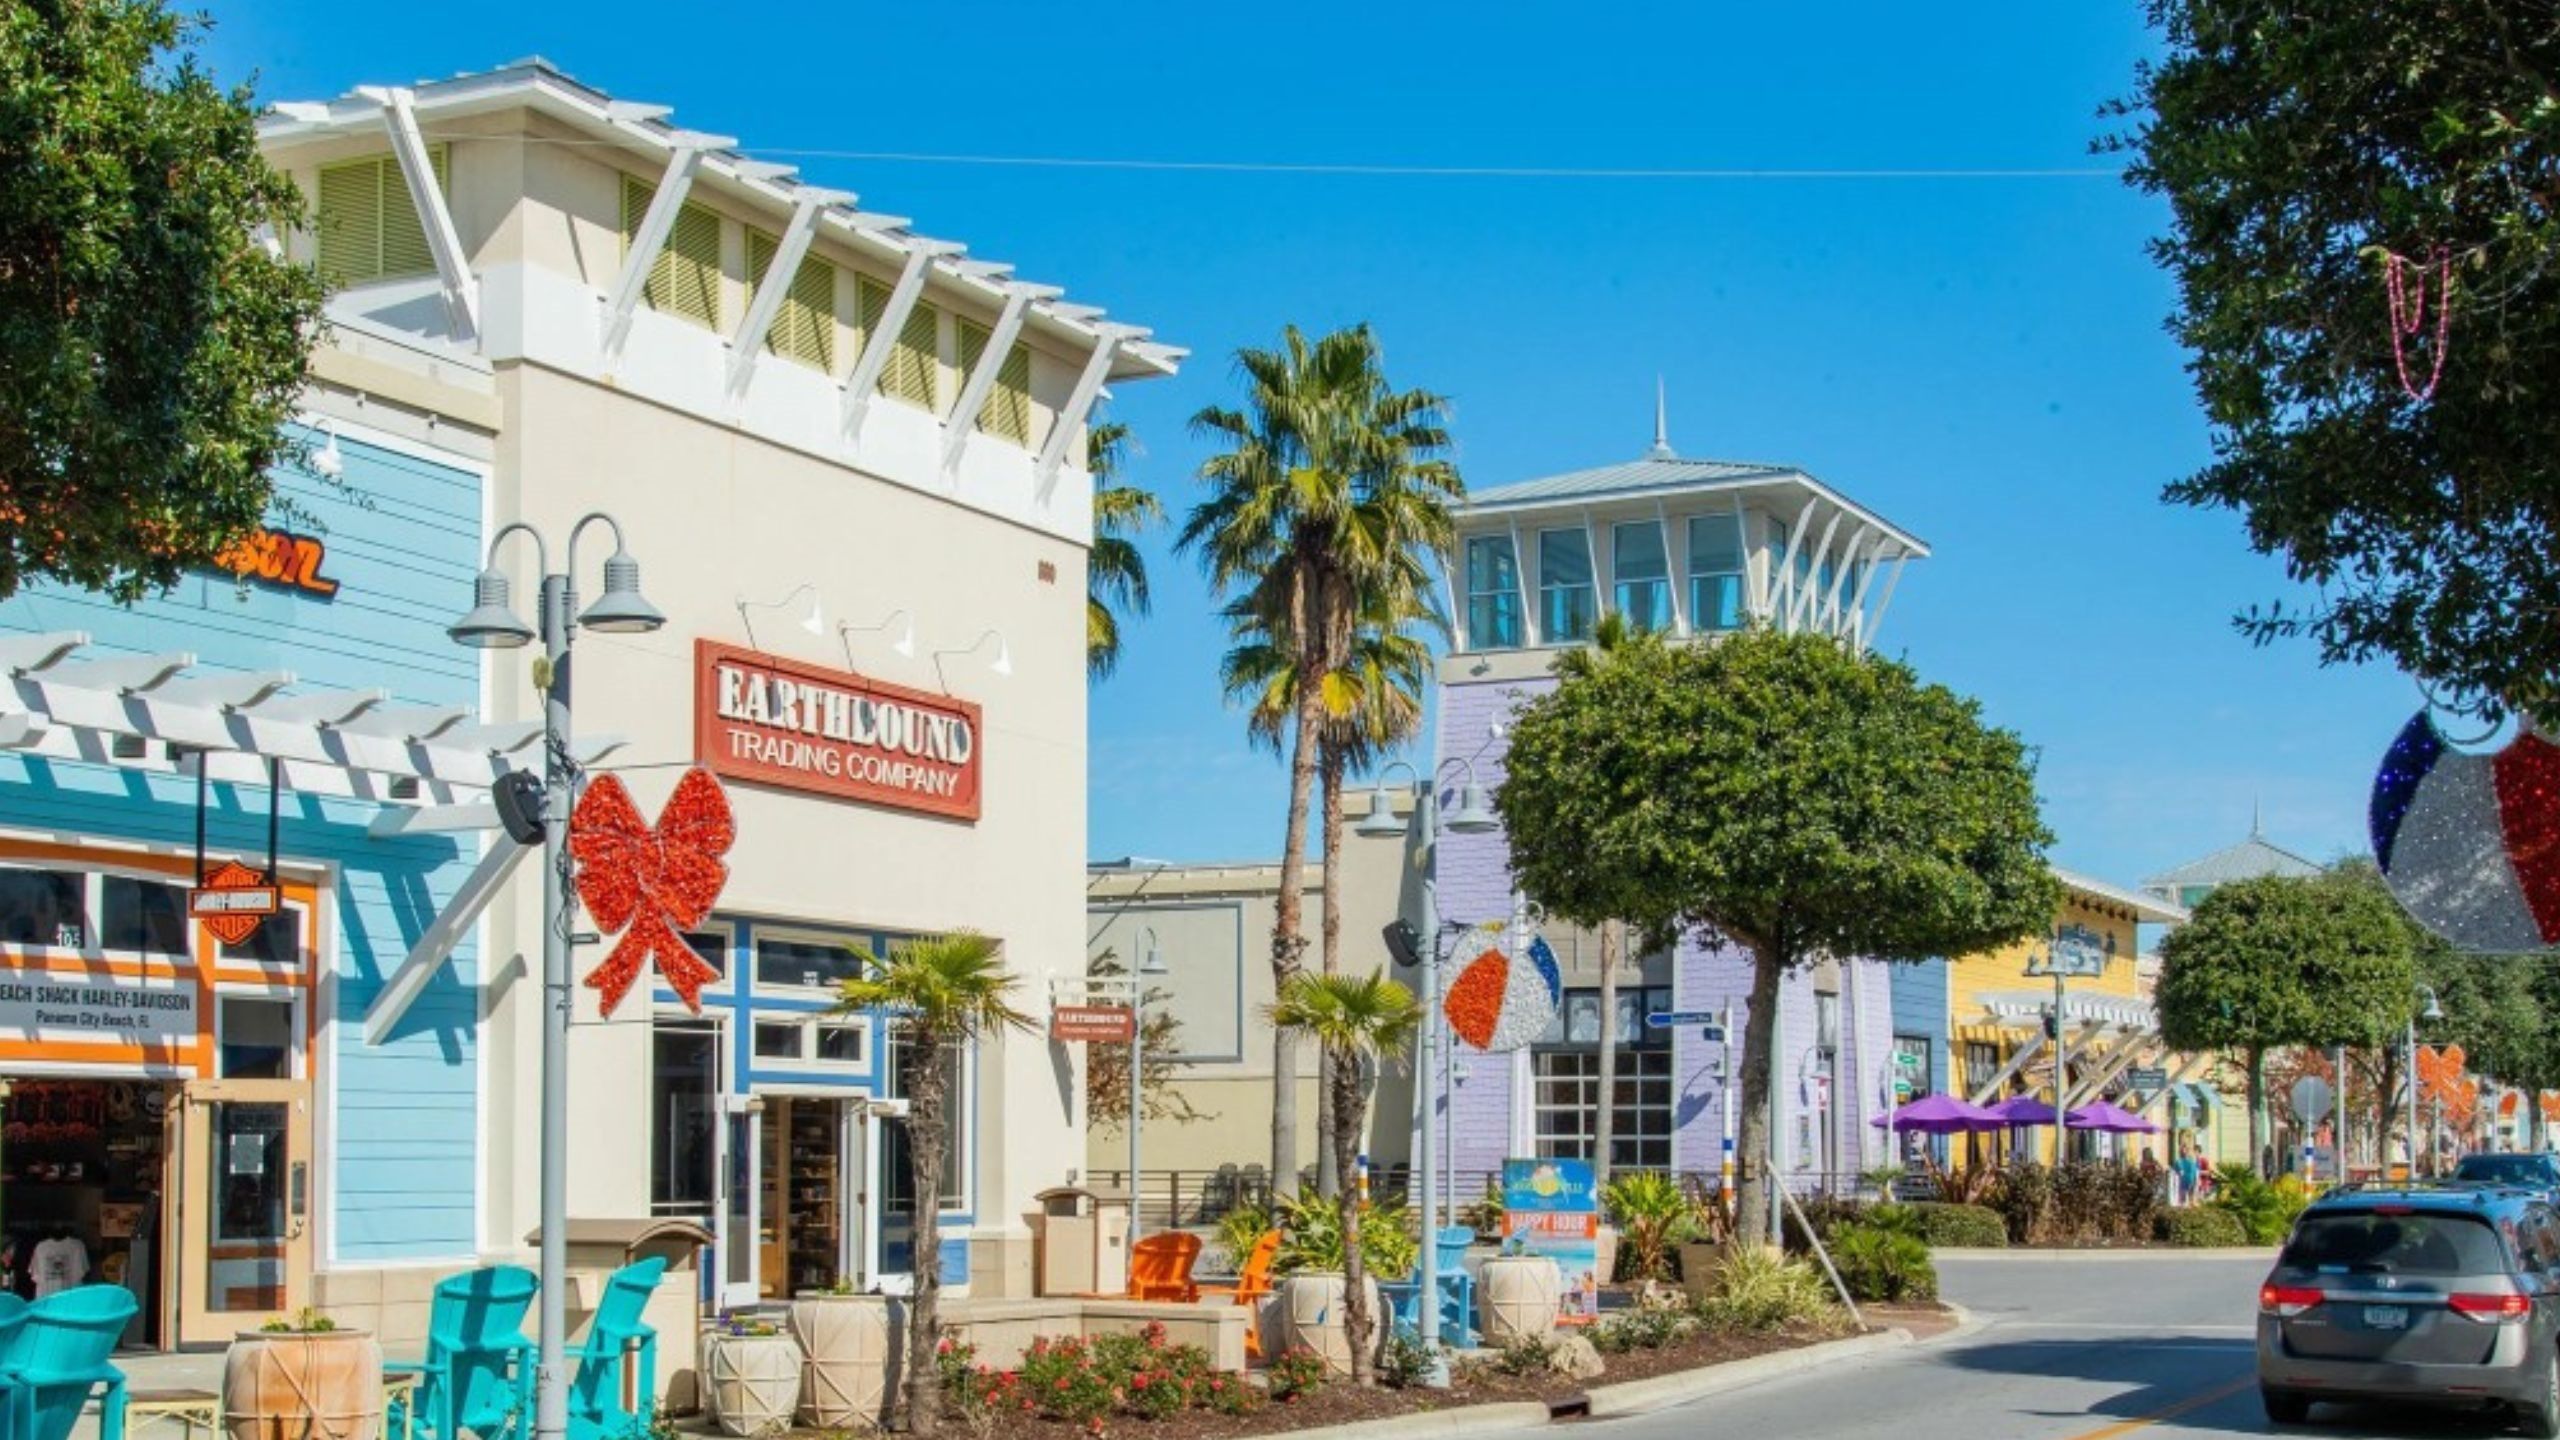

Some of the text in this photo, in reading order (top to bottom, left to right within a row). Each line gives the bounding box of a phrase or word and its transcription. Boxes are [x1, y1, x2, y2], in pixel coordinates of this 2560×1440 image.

[716, 664, 973, 765] EARTHBOUND
[727, 728, 959, 798] TRADING COMPANY
[56, 932, 81, 948] 105
[0, 983, 190, 1011] EACH SHACK HARLEY-DAVIDSON
[36, 1010, 77, 1024] Panama
[80, 1012, 100, 1029] City
[1553, 1213, 1587, 1232] HOUR
